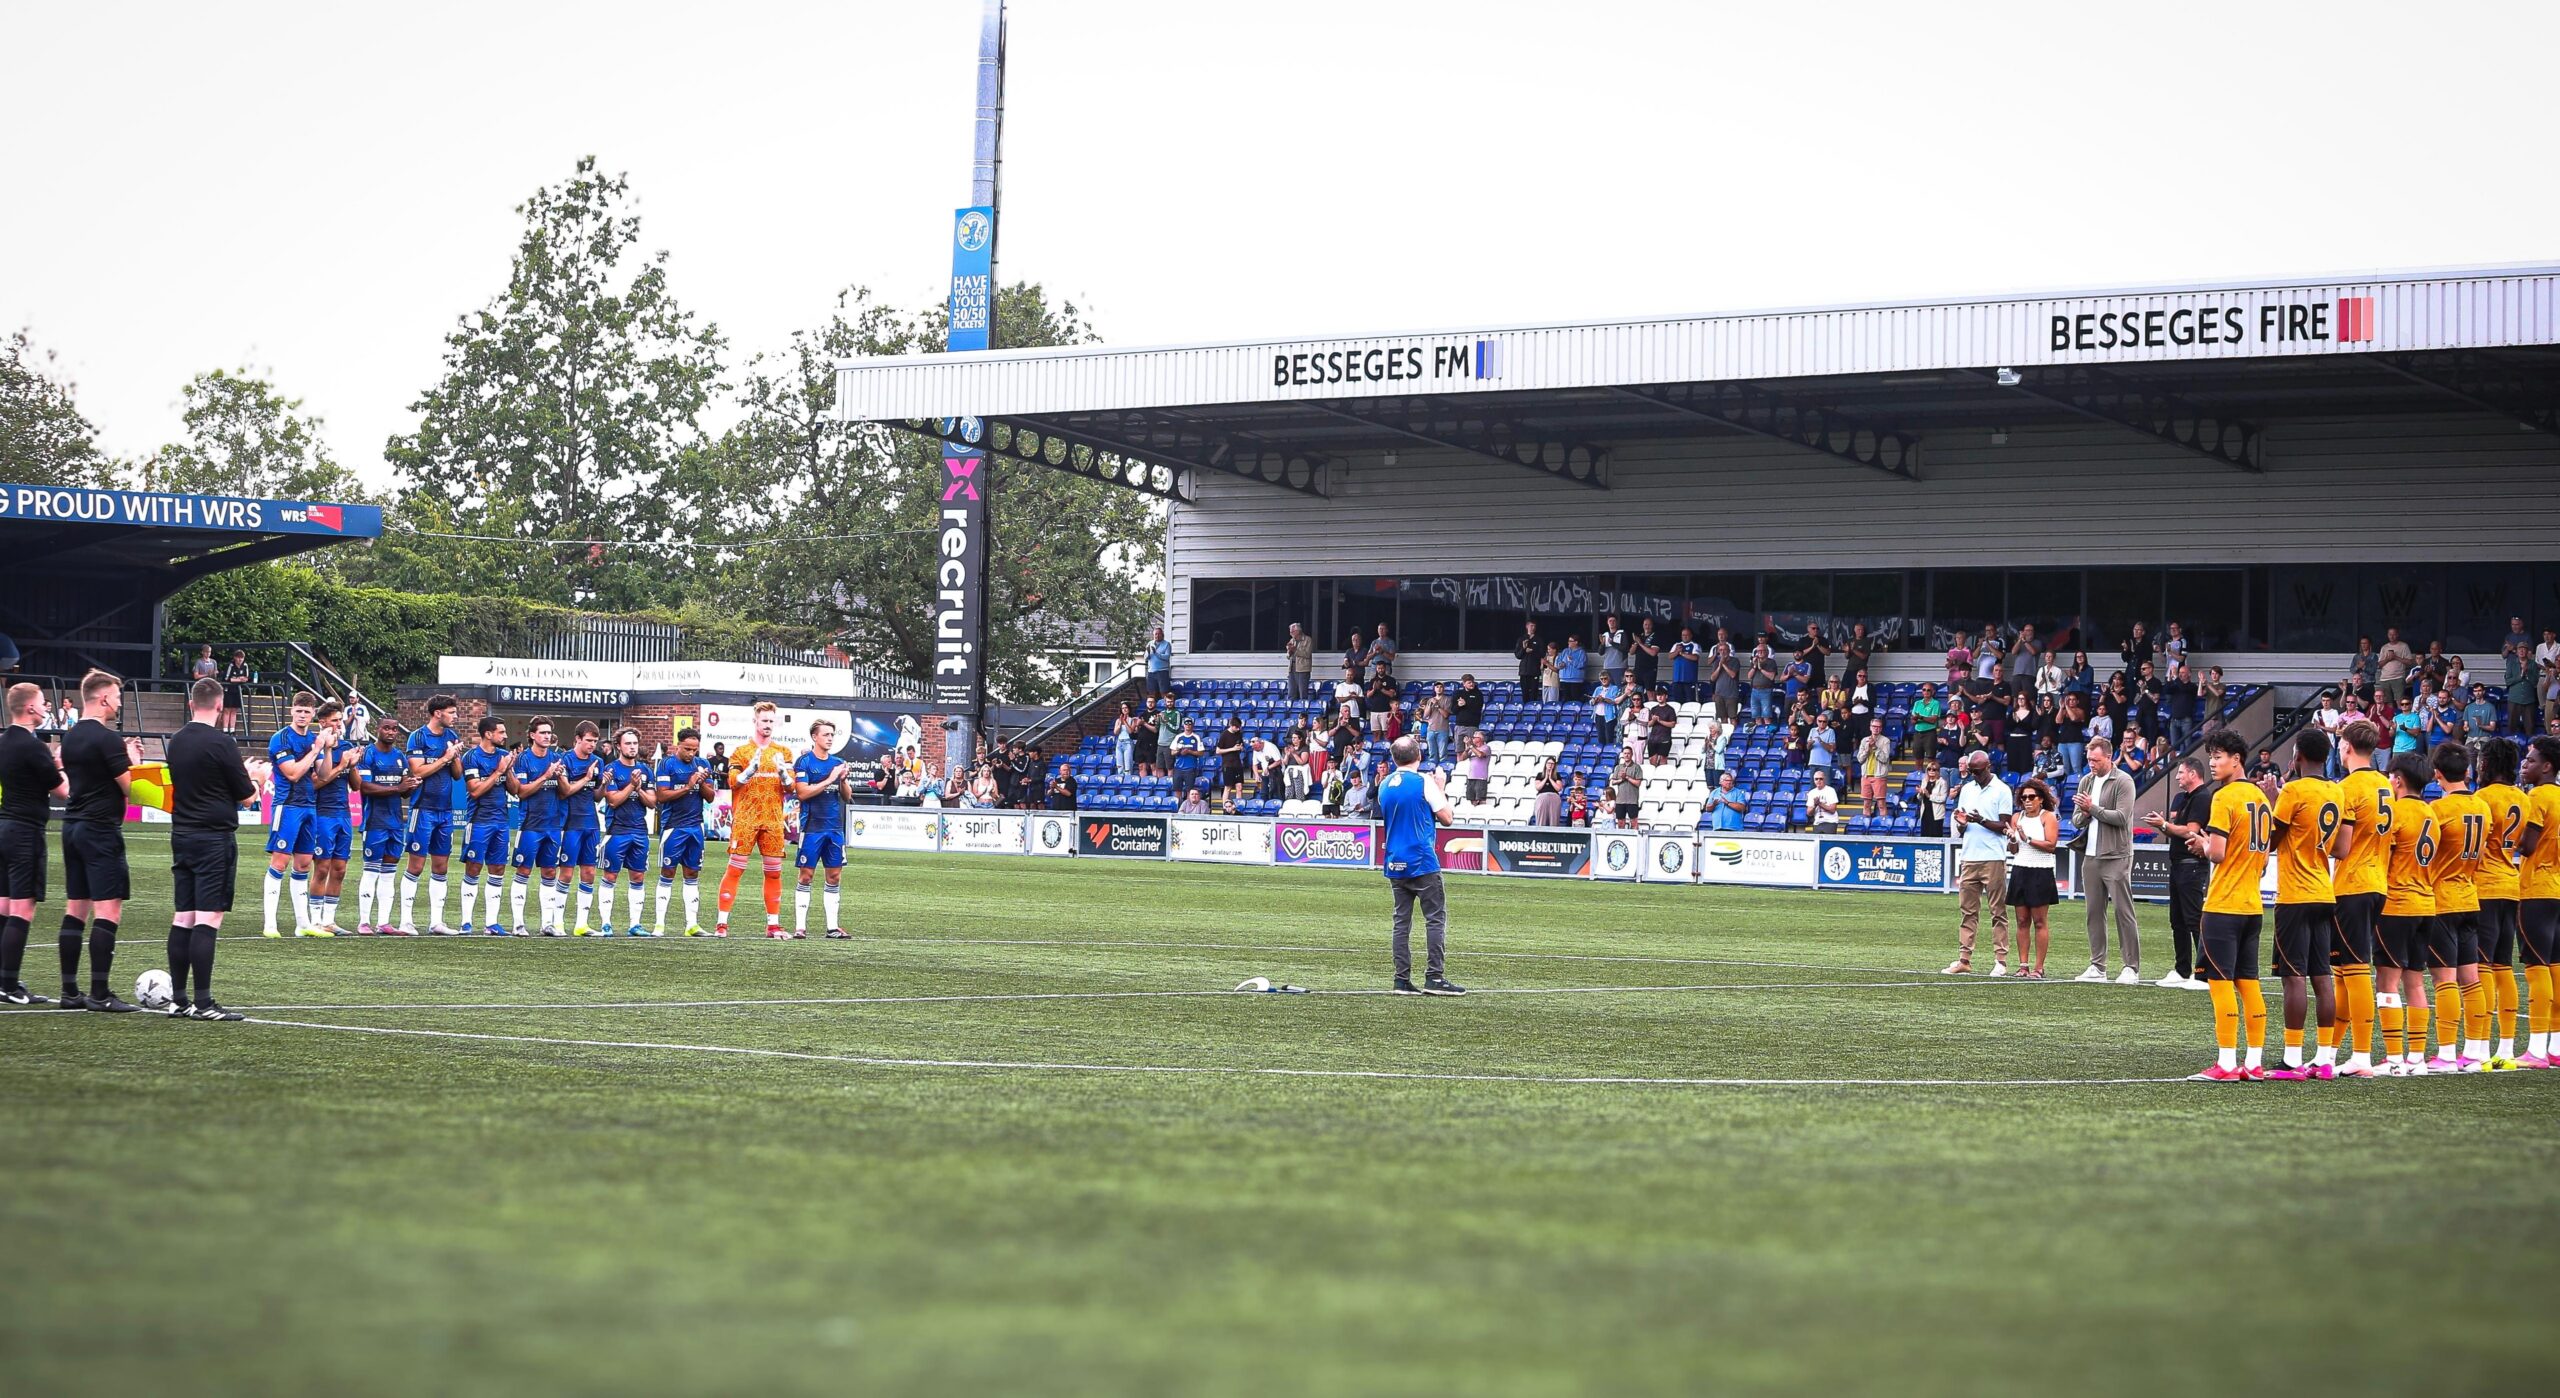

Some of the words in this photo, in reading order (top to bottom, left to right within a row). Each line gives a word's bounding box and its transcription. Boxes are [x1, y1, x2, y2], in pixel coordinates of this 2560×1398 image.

[954, 275, 987, 289] HAVE
[954, 288, 969, 296] YOU
[971, 287, 986, 296] GOT
[954, 295, 986, 308] YOUR
[953, 307, 986, 321] 50/50
[2052, 307, 2244, 350] BESSEGES
[2260, 303, 2330, 342] FIRE
[1274, 347, 1423, 386] BESSEGES
[1434, 345, 1470, 378] FM
[17, 489, 115, 520] PROUD
[122, 494, 193, 524] WITH
[201, 500, 262, 528] WRS
[281, 509, 307, 522] WRS
[937, 509, 973, 675] recruit
[496, 666, 530, 677] ROYAL
[537, 667, 588, 679] LONDON
[514, 688, 617, 704] REFRESHMENTS
[706, 733, 748, 741] Measurement
[2376, 788, 2393, 836] 5
[965, 817, 1002, 838] spiral
[1112, 824, 1162, 840] DeliverMy
[2246, 802, 2273, 853] 10
[2316, 801, 2340, 850] 9
[2501, 804, 2521, 849] 2
[1202, 823, 1242, 845] spiral
[2461, 814, 2484, 859] 11
[1111, 838, 1160, 852] Container
[1307, 841, 1332, 857] Silk
[1498, 840, 1583, 854] DOORS4SECURITY
[2415, 818, 2436, 867] 6
[1746, 849, 1805, 861] FOOTBALL
[1858, 857, 1907, 870] SILKMEN
